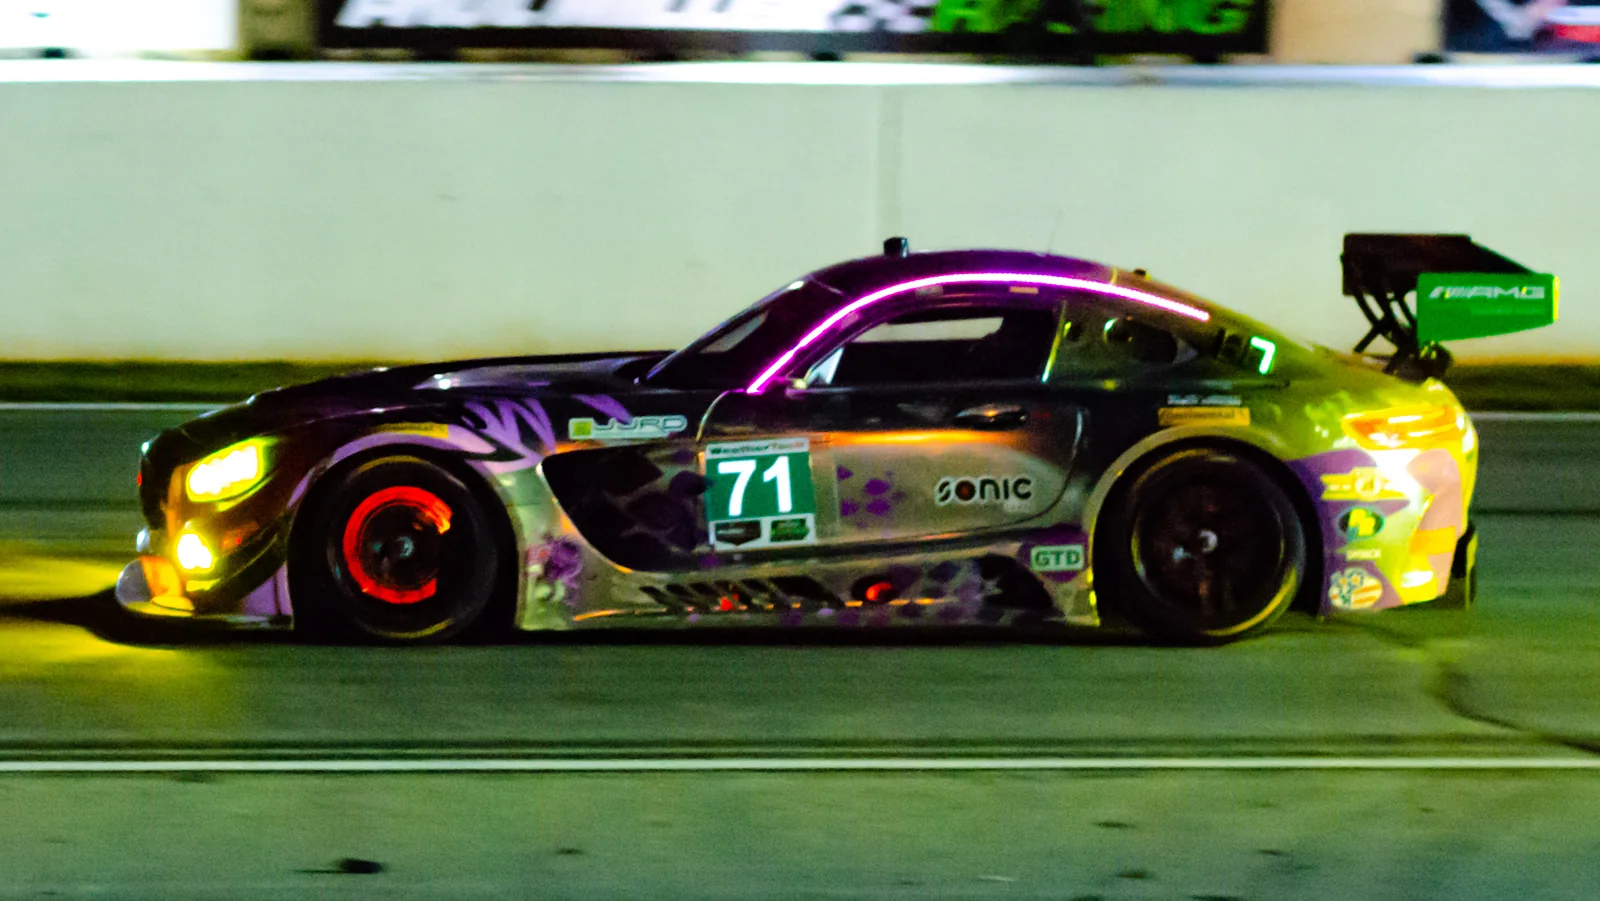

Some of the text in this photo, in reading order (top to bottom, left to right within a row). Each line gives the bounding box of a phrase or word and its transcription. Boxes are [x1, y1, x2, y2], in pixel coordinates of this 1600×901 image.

[1249, 335, 1277, 375] 7
[717, 455, 793, 517] 71
[1034, 549, 1081, 567] GTD
